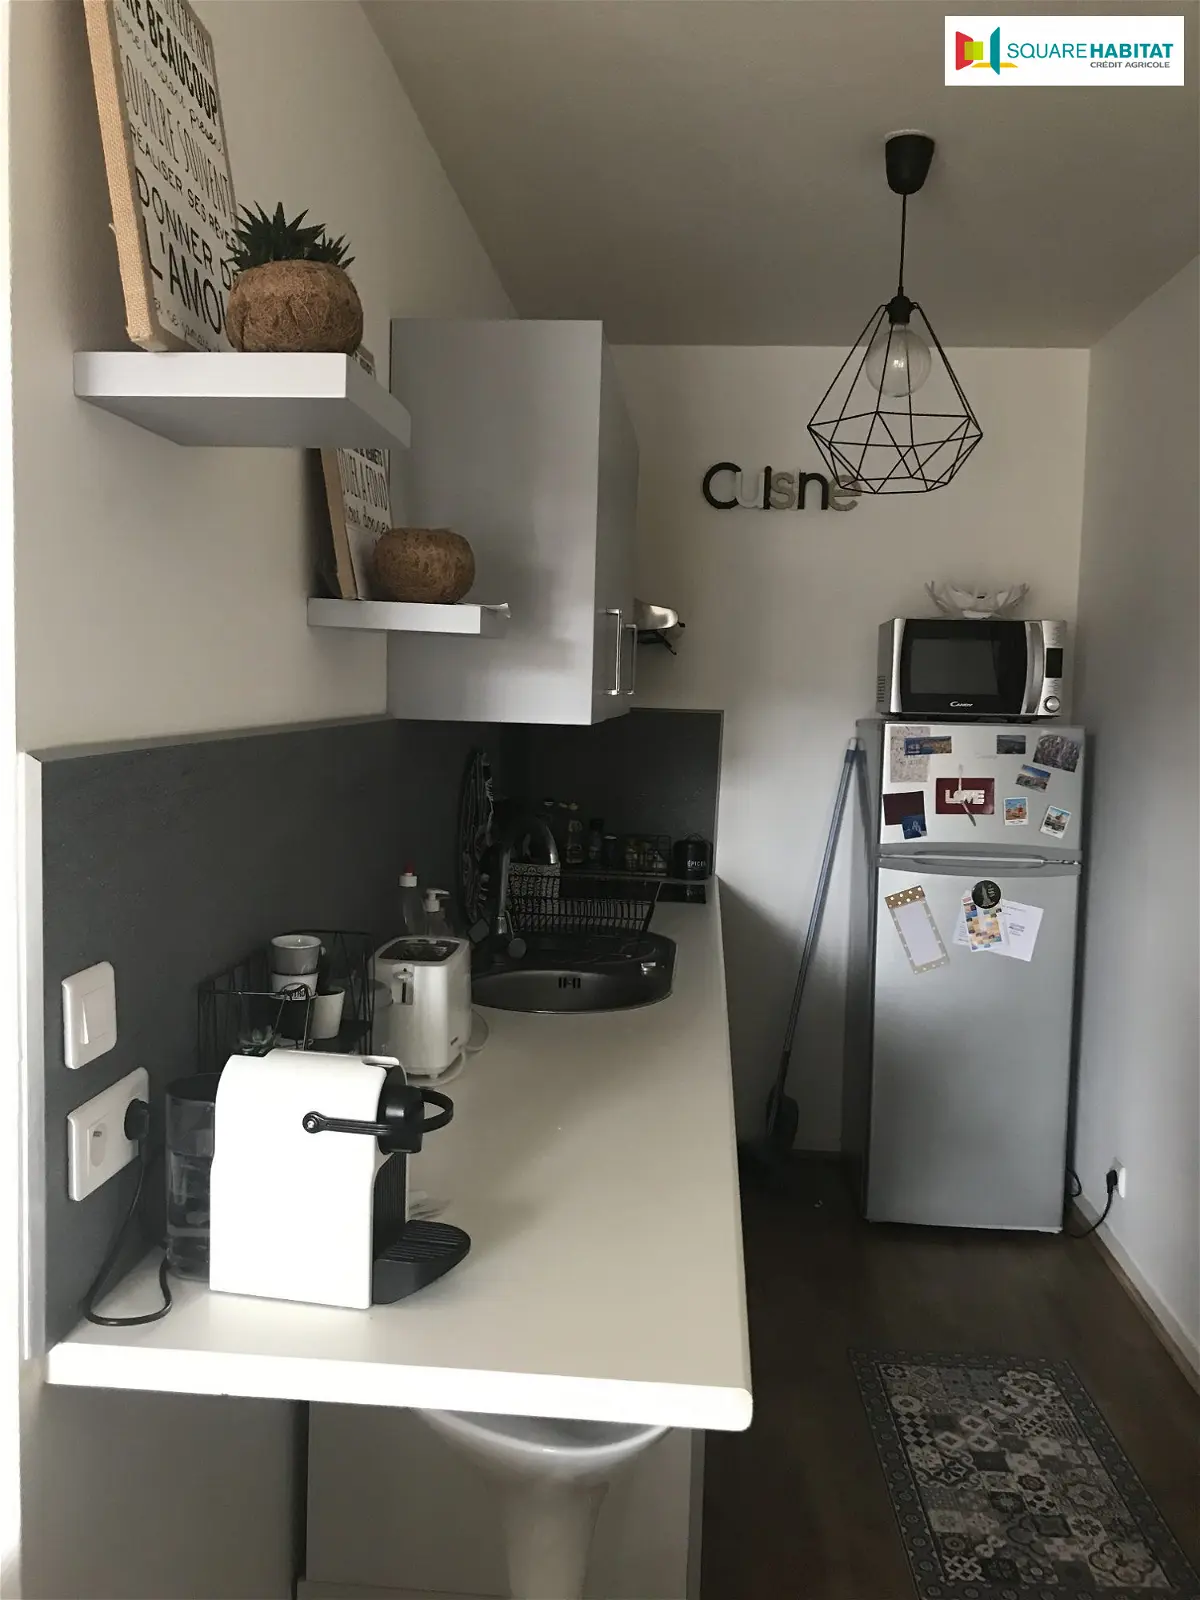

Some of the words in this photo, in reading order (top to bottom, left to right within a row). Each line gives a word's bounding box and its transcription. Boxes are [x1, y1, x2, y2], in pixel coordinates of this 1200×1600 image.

[146, 0, 217, 127] BEAUCOUP
[120, 45, 180, 164] SOURIRE
[177, 120, 233, 225] SOUVENT
[130, 122, 183, 196] RÉALISER
[187, 188, 206, 224] SES
[135, 166, 215, 277] DONNER
